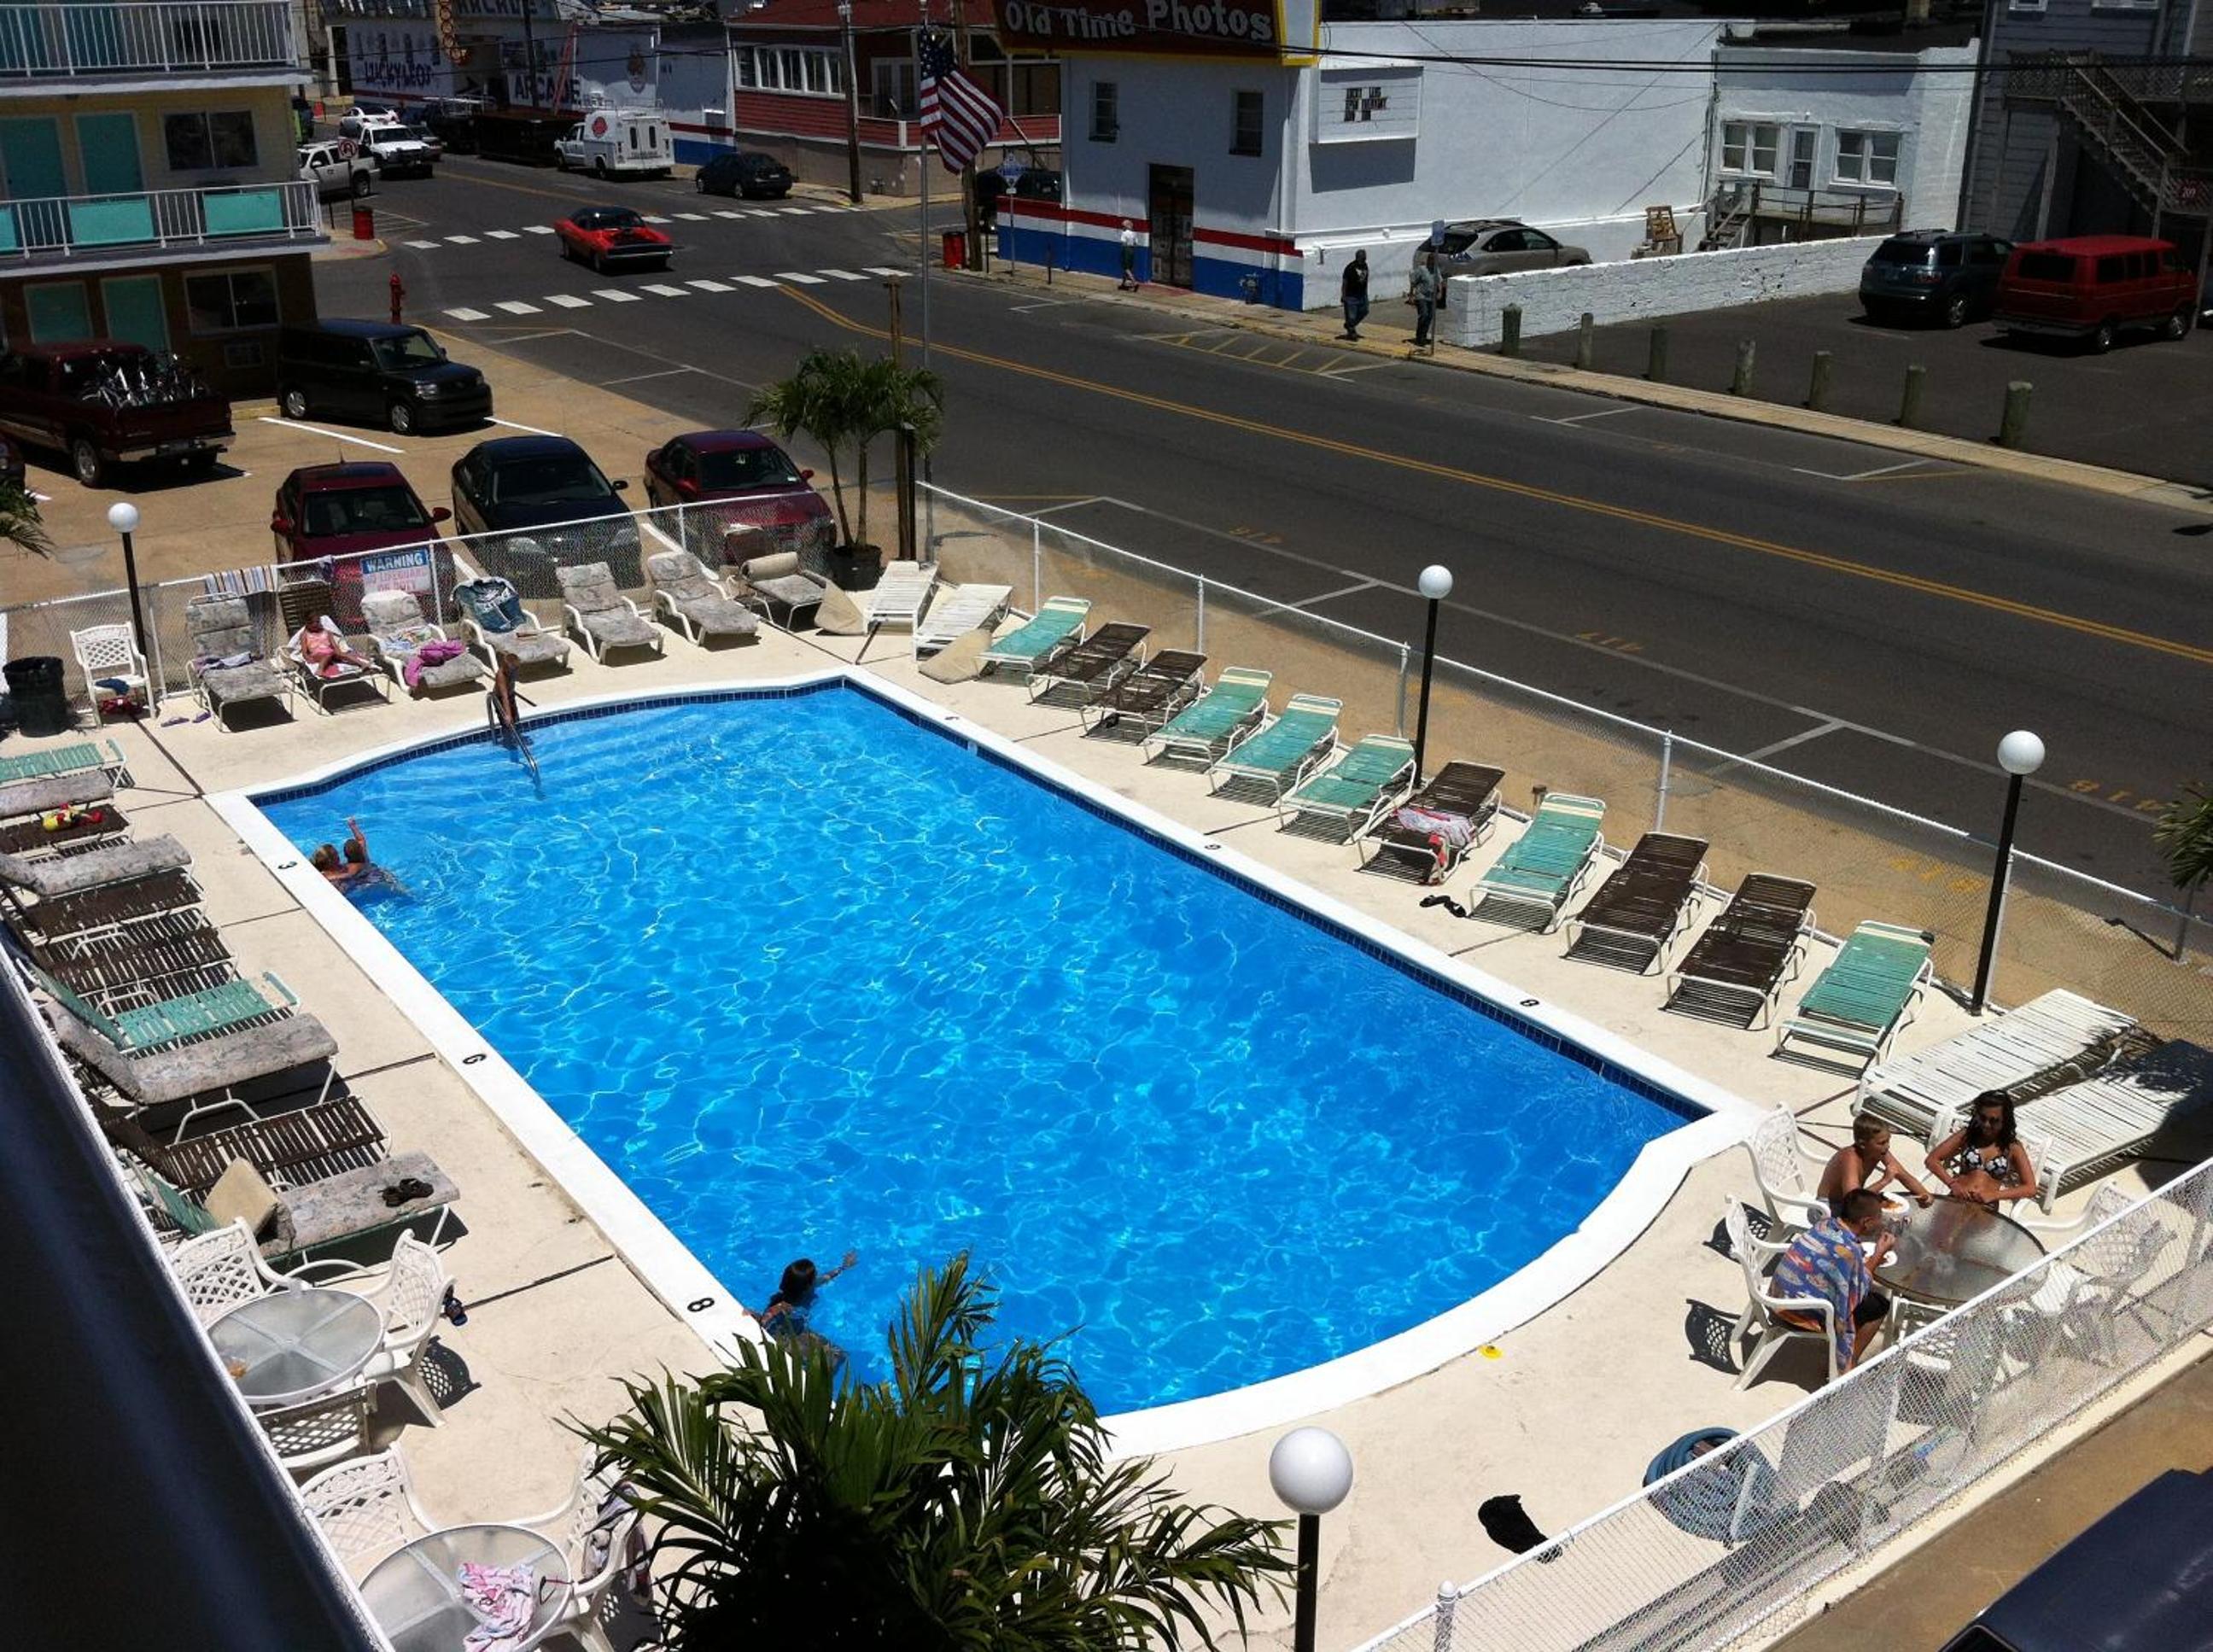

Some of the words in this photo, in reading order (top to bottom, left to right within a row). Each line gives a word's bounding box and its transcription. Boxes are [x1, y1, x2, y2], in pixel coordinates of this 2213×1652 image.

[1006, 0, 1051, 34] Old
[1060, 7, 1136, 38] Time
[1147, 0, 1273, 40] Photos
[366, 552, 423, 572] WARNING
[687, 1298, 715, 1312] 8
